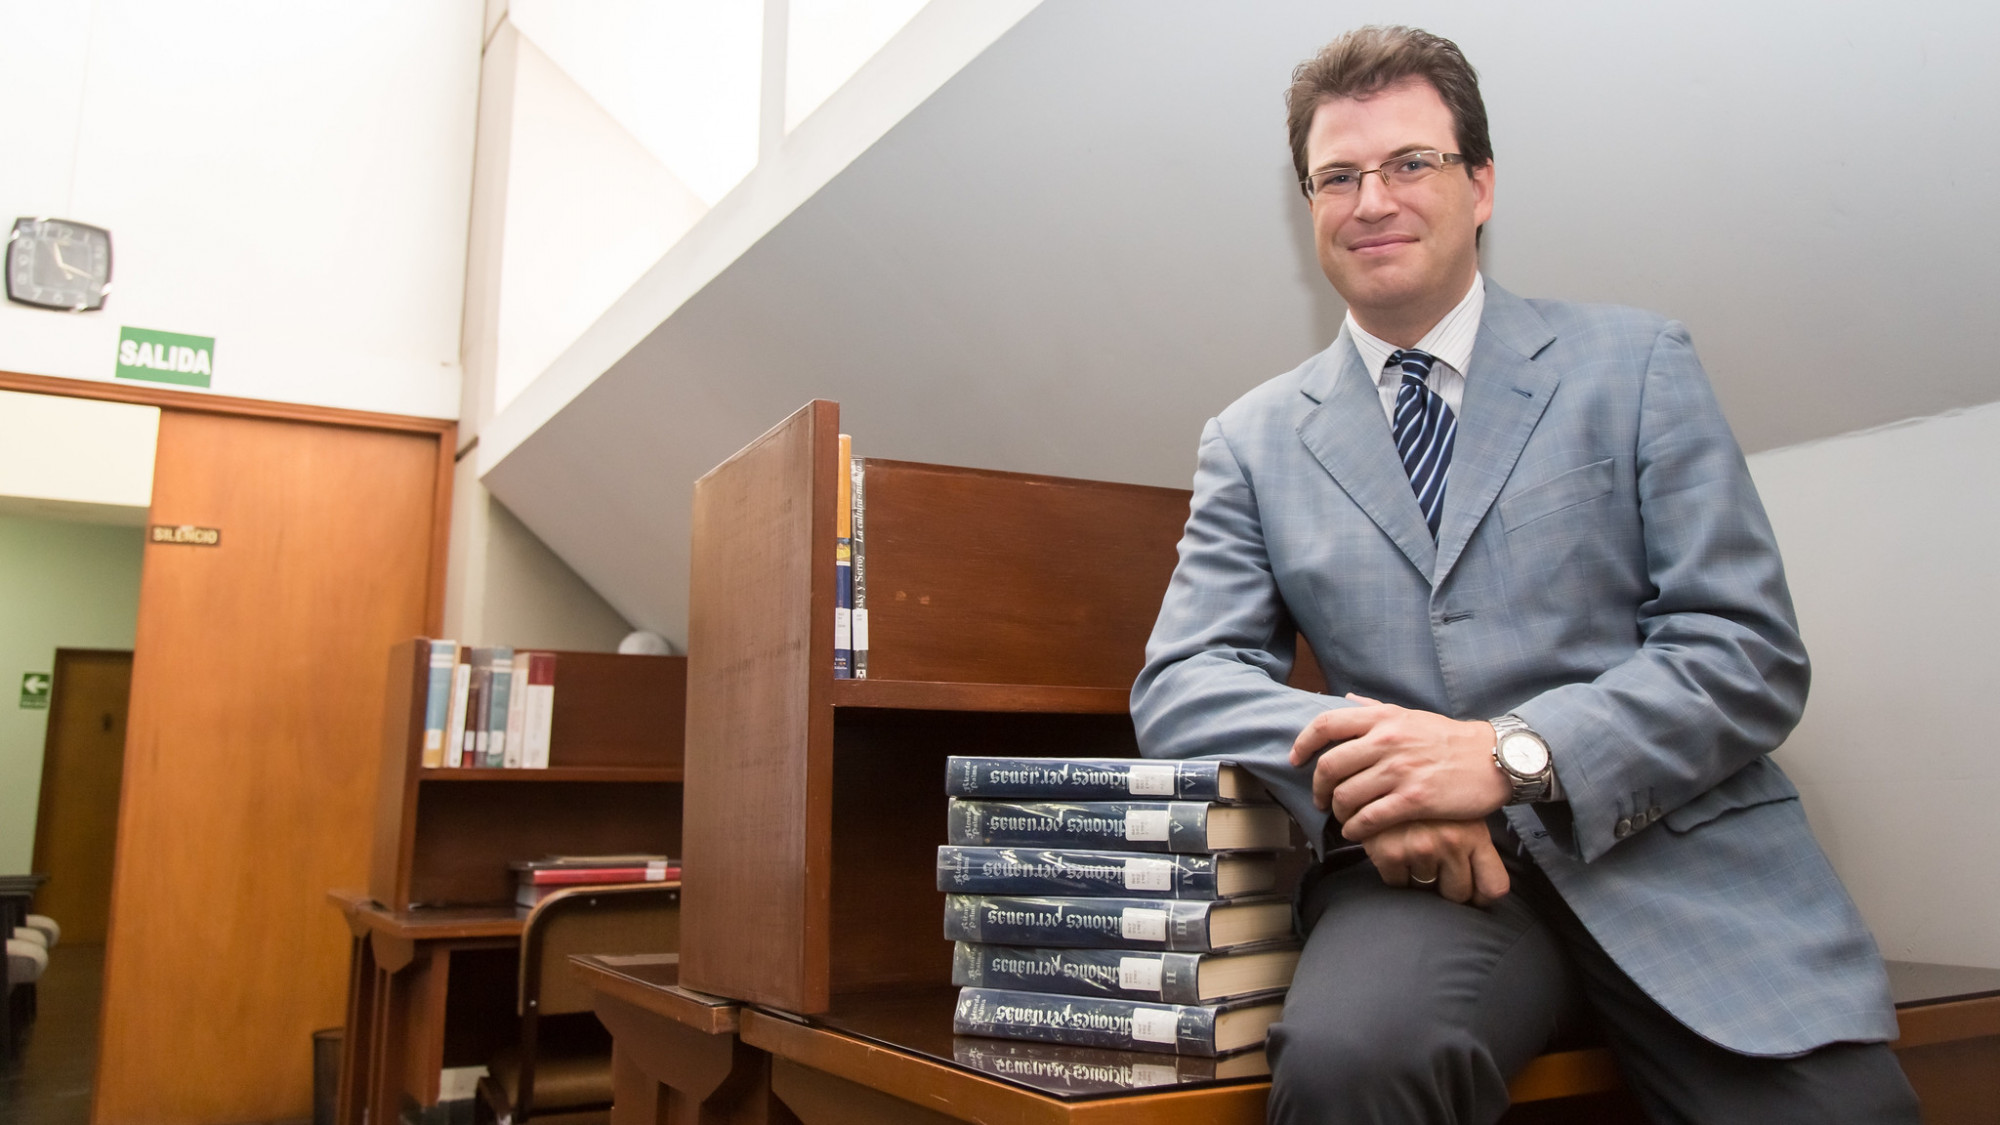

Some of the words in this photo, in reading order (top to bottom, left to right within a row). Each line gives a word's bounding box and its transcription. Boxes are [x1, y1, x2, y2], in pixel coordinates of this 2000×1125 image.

[119, 339, 211, 375] SALIDA
[152, 526, 218, 545] SILENCIO
[854, 530, 864, 543] La
[855, 594, 866, 609] sky
[1184, 771, 1197, 790] VI
[971, 810, 980, 837] Palm
[989, 808, 1064, 832] peruanas
[1172, 821, 1185, 834] V
[982, 856, 1063, 878] peruanas
[1182, 866, 1194, 885] IV
[987, 905, 1064, 927] peruanas
[1176, 920, 1188, 936] III
[991, 954, 1062, 977] peruanas
[1166, 971, 1177, 984] II
[996, 1003, 1072, 1027] peruanas
